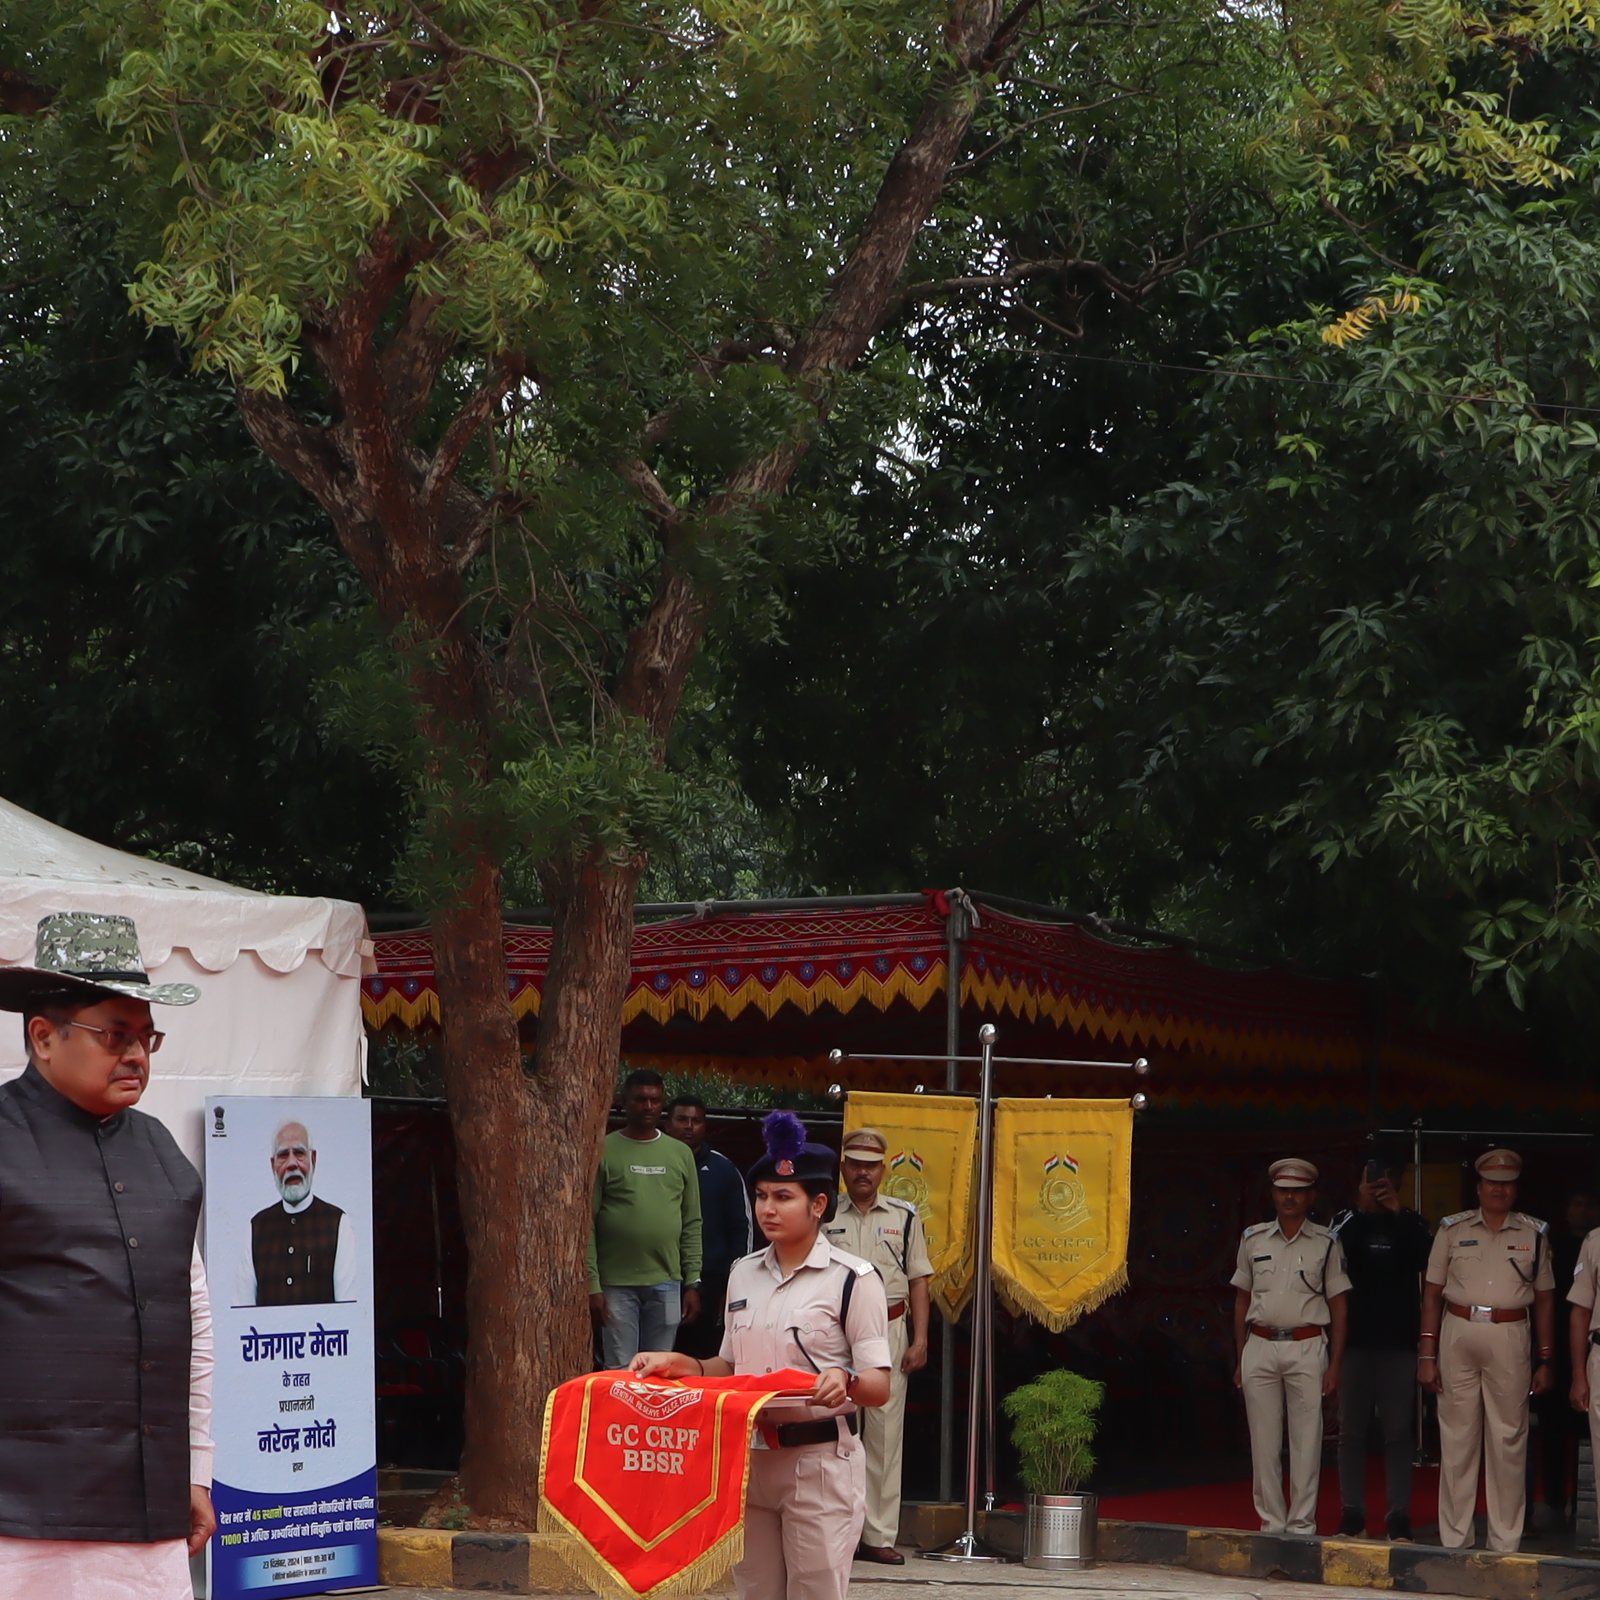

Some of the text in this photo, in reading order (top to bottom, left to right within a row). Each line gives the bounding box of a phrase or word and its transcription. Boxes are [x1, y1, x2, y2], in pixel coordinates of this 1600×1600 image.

[1023, 1237, 1096, 1249] GC CRPF
[1038, 1252, 1081, 1263] BBSR
[240, 1322, 349, 1362] रोजगार मेला
[282, 1370, 311, 1388] के तहत
[279, 1394, 315, 1413] प्रधानमंत्री
[612, 1387, 698, 1418] CENTRAL RESERVE POLICE FORCE
[257, 1418, 337, 1453] नरेन्द्र मोदी
[607, 1423, 700, 1451] GC CRPF
[623, 1448, 684, 1475] BBSR
[220, 1496, 375, 1525] देश भर में 45 स्थानों पर सरकारी नौकरियों में चयनित
[221, 1533, 241, 1547] 71000
[242, 1530, 250, 1544] से
[250, 1527, 270, 1543] अधिक
[301, 1522, 310, 1537] को
[345, 1521, 353, 1532] का
[353, 1517, 375, 1531] वितरण
